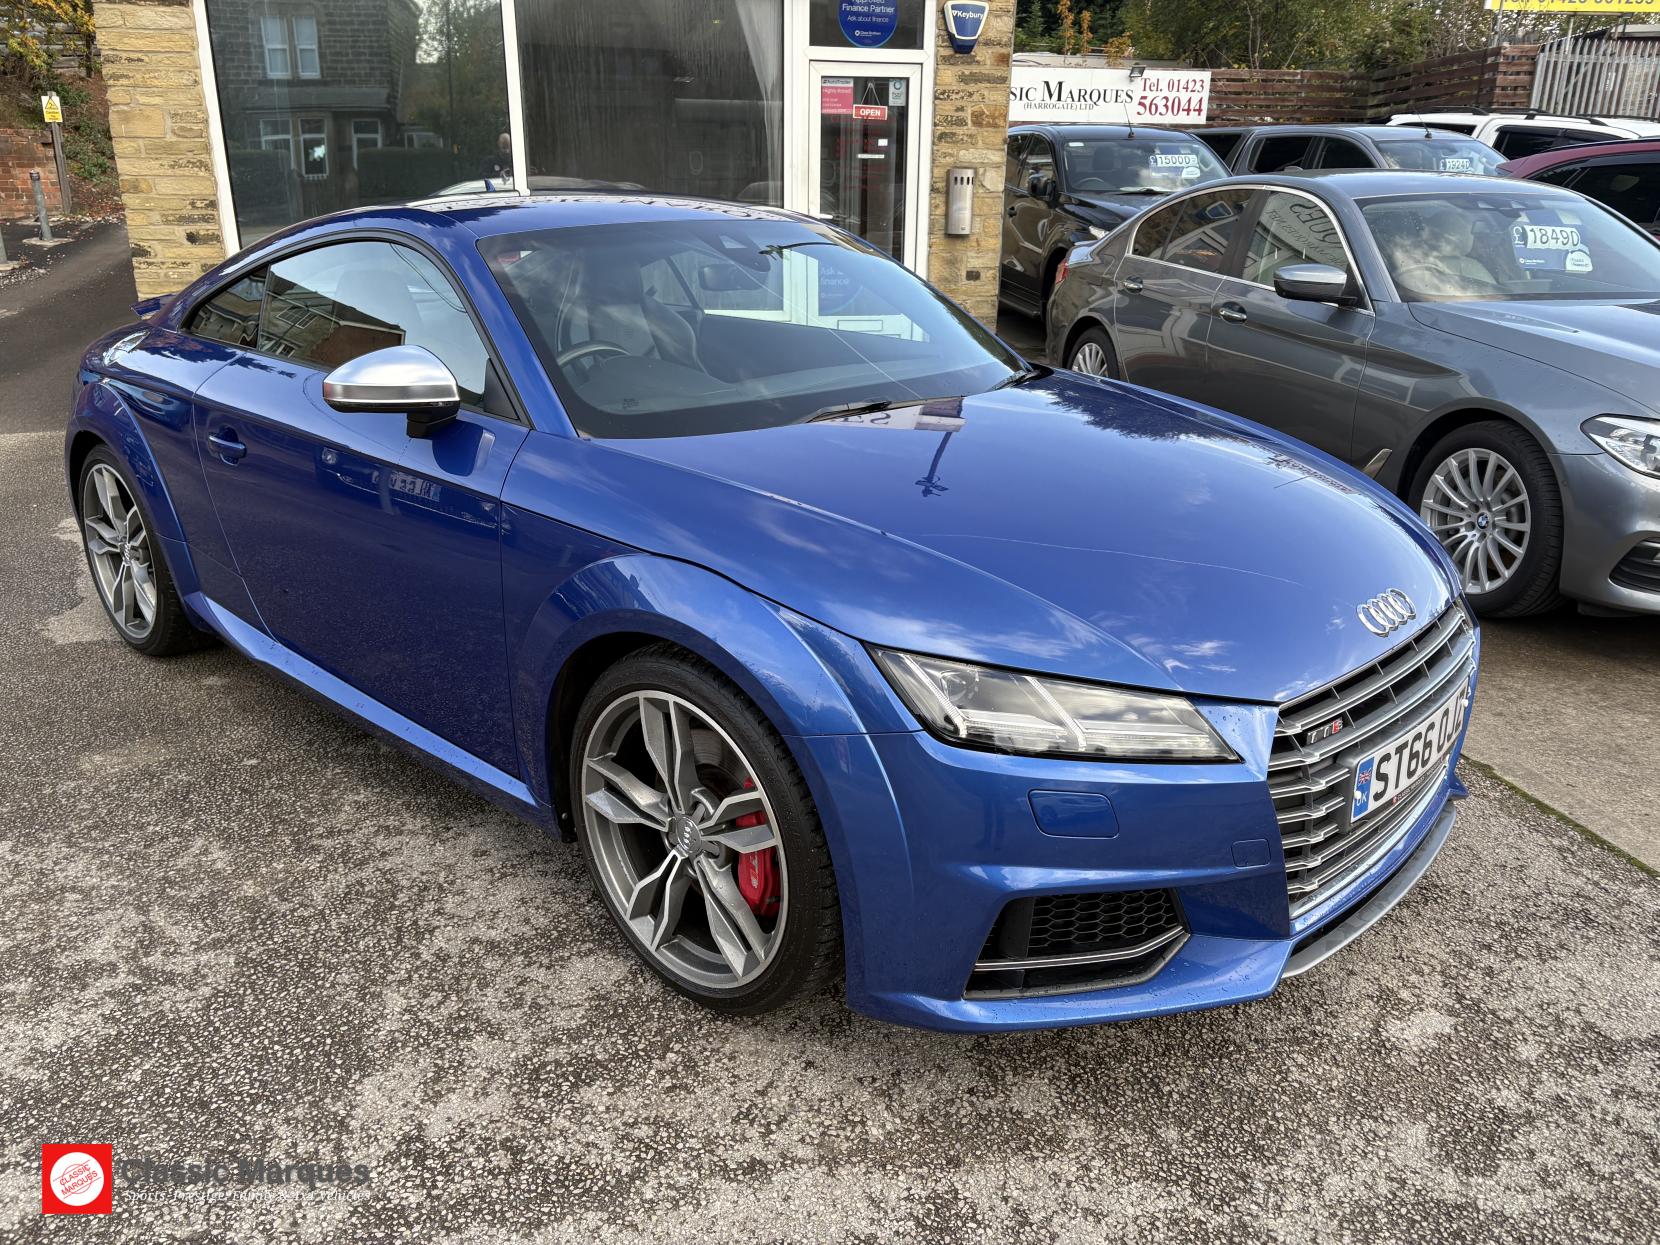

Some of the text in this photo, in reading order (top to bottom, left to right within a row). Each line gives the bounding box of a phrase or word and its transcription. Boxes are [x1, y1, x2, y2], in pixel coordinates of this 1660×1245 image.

[842, 3, 895, 13] Finance Partner
[957, 10, 984, 19] Keybury
[1141, 77, 1205, 93] Tel. 01423
[1041, 80, 1134, 106] MARQUES
[860, 108, 880, 116] OPEN
[1023, 102, 1094, 111] (HARROGATE) LTD
[1136, 95, 1203, 116] 563044
[1372, 721, 1436, 802] ST66
